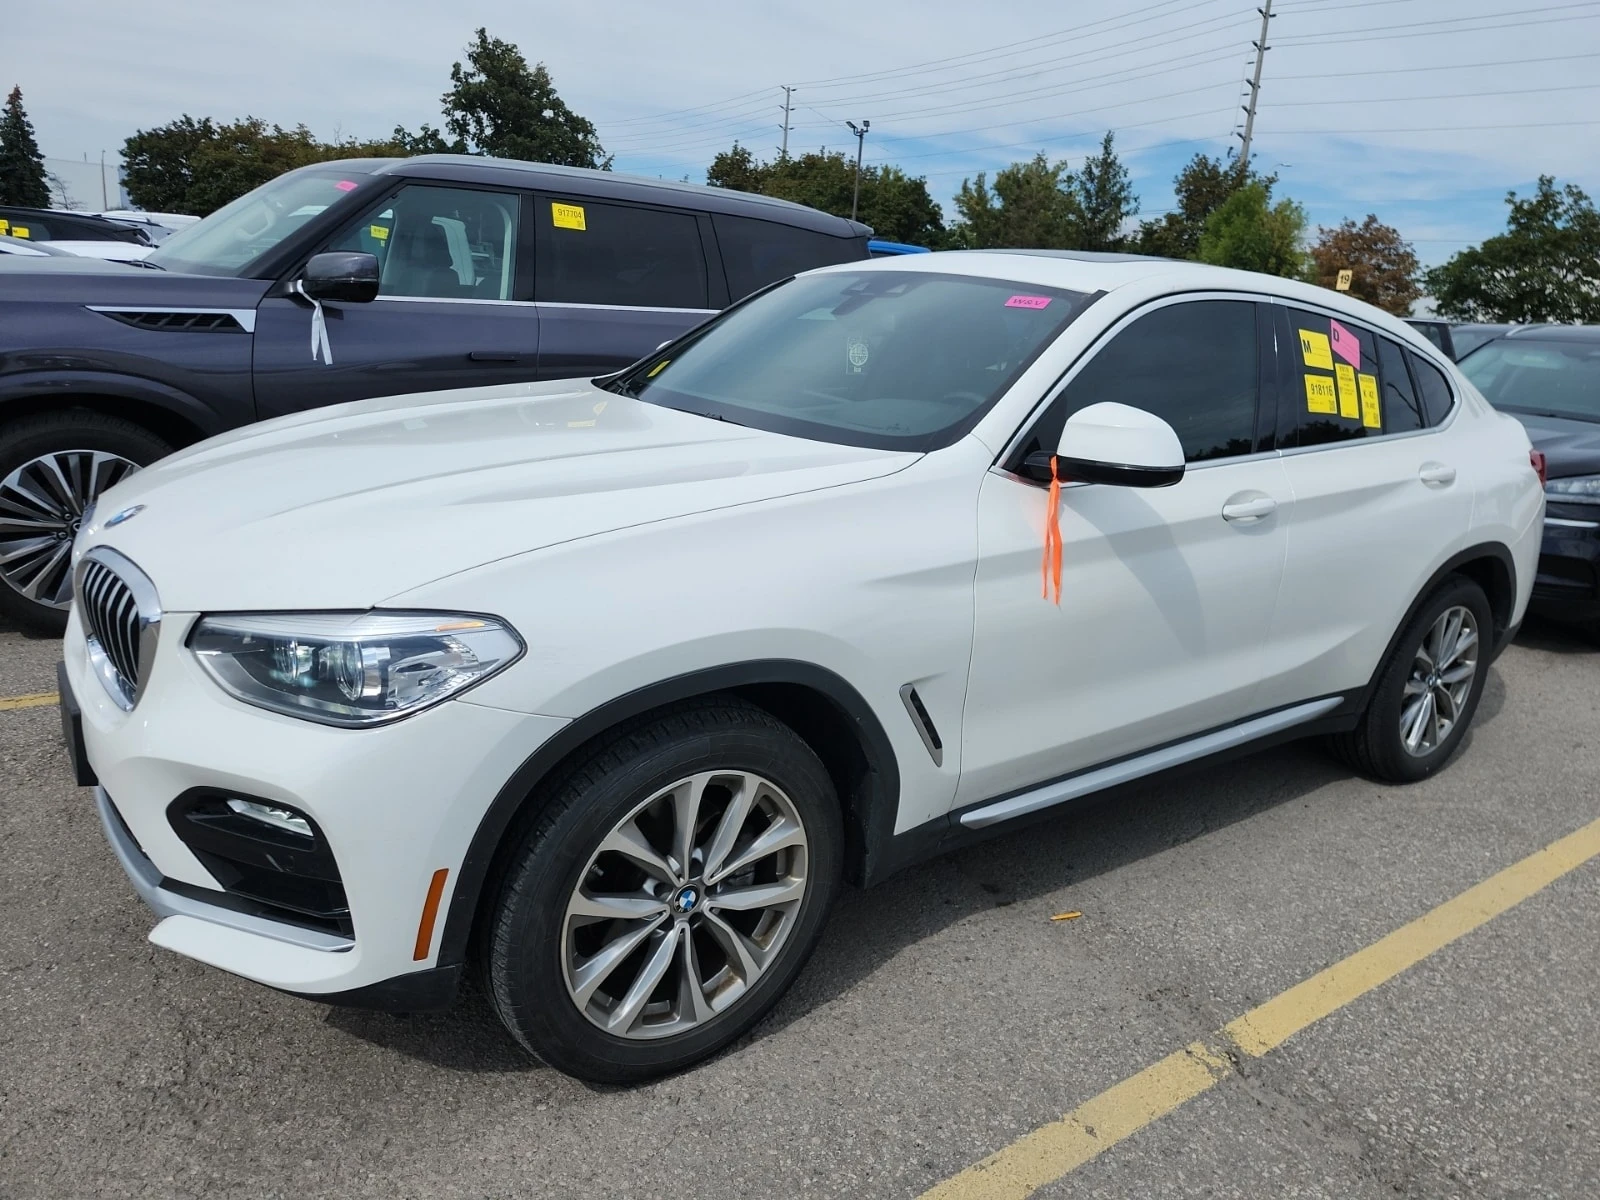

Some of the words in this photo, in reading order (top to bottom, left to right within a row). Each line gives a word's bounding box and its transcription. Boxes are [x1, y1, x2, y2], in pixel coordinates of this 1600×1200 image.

[1340, 274, 1350, 284] 19
[1333, 328, 1340, 343] D
[1302, 339, 1312, 354] M
[1310, 383, 1333, 397] 918116
